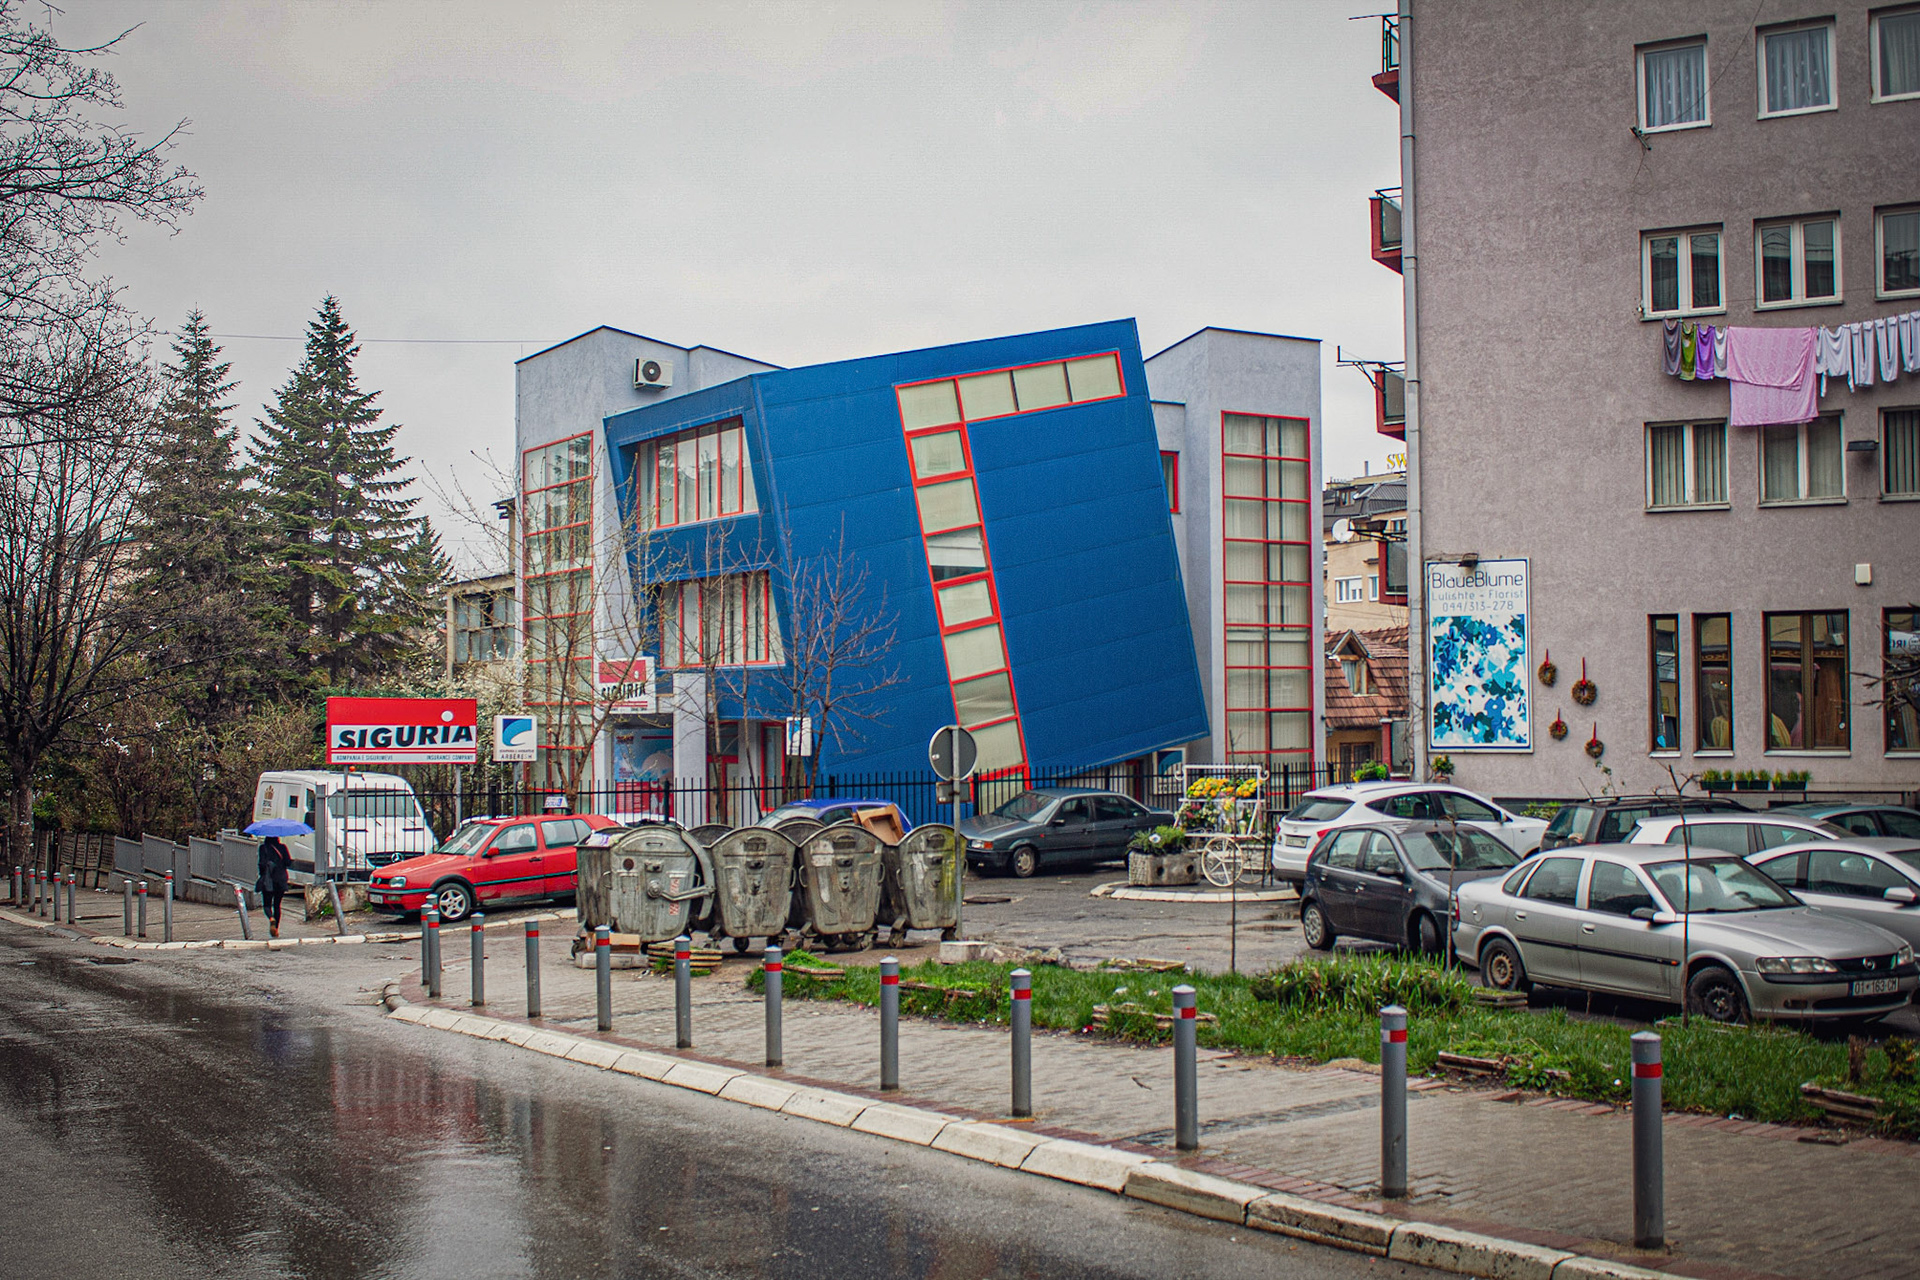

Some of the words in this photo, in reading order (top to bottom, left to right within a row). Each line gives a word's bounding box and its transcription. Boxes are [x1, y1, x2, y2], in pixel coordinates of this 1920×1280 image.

[1432, 571, 1524, 589] BlaueBlume
[1432, 591, 1475, 601] Lulishte
[1489, 589, 1524, 600] Florist
[1442, 601, 1514, 612] 044/313-278
[337, 725, 474, 749] SIGURIA
